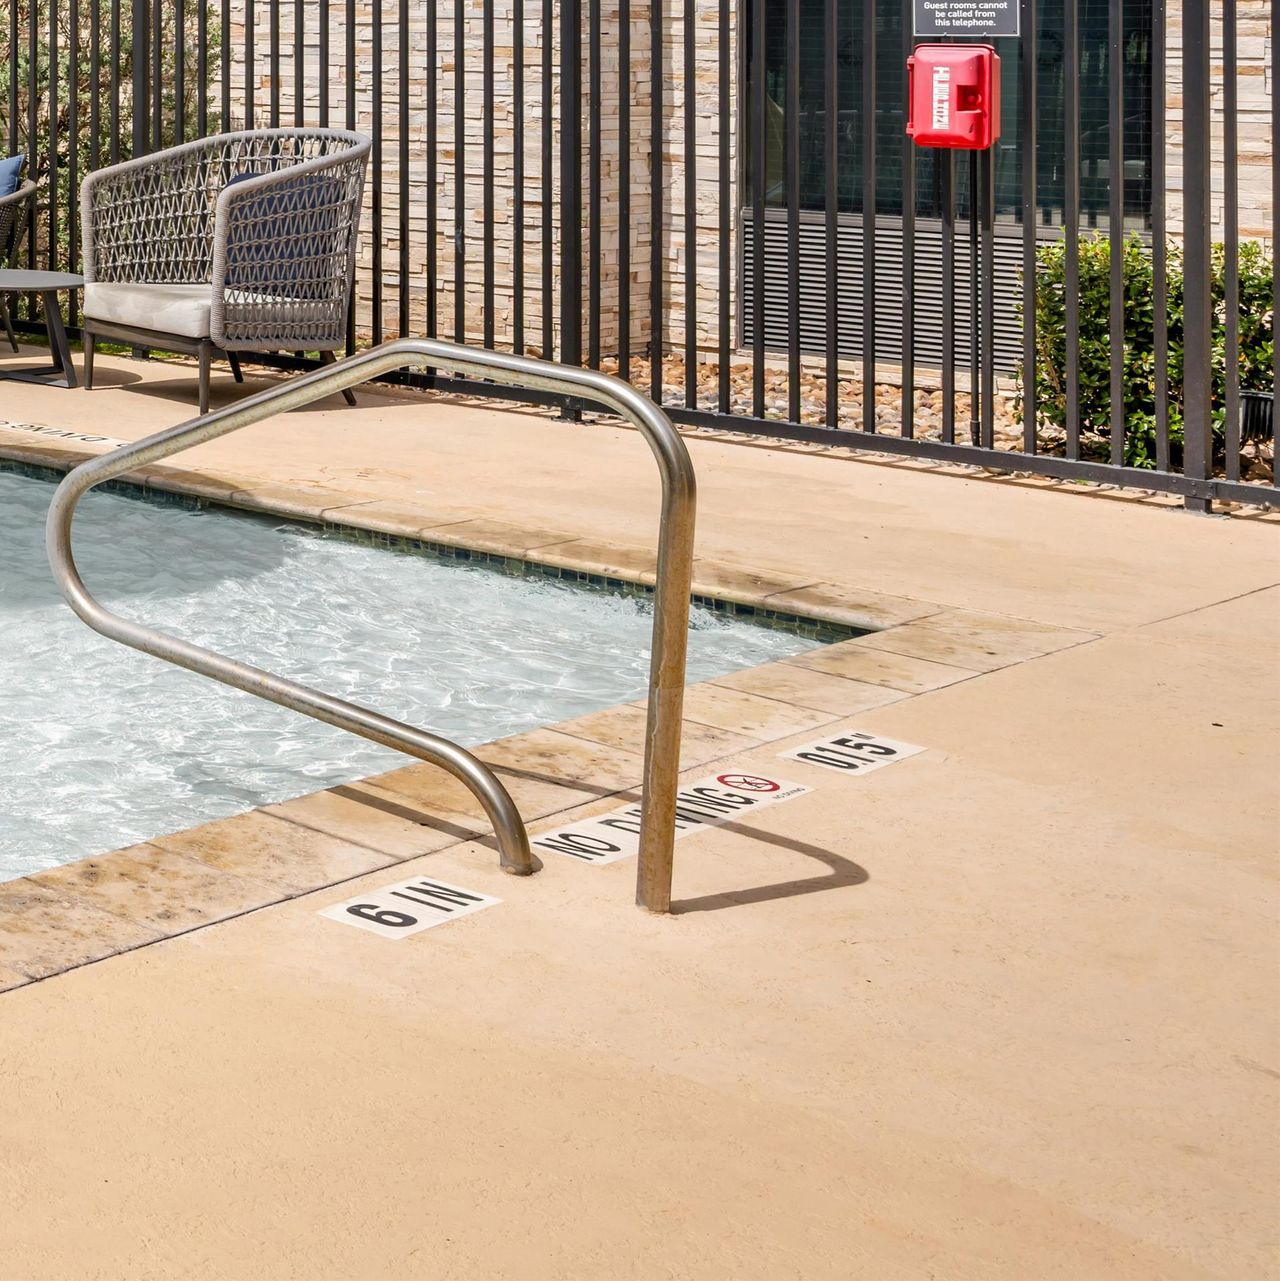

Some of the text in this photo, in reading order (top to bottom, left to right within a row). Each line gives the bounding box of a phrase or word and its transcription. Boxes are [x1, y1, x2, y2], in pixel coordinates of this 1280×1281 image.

[978, 1, 1008, 9] cannot
[935, 10, 996, 18] be called from
[935, 18, 996, 28] this telephone.
[532, 832, 622, 861] NO
[346, 881, 485, 928] 6 IN
